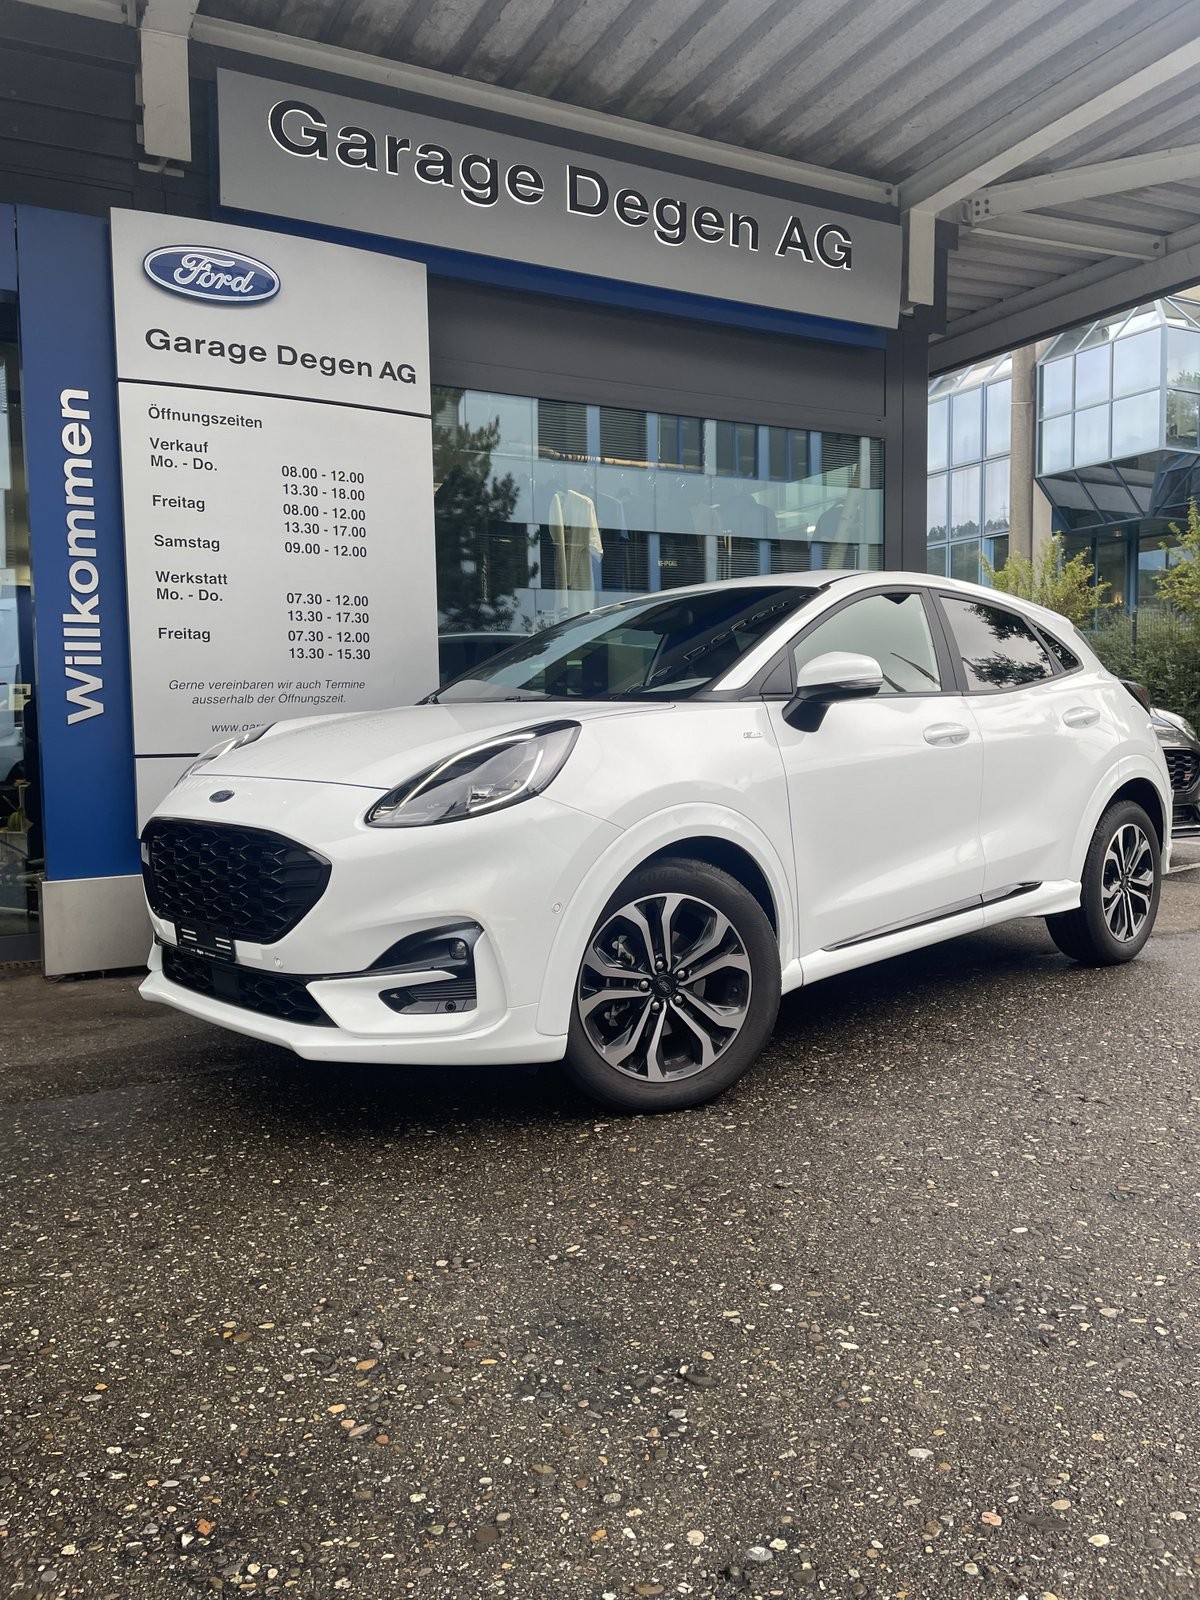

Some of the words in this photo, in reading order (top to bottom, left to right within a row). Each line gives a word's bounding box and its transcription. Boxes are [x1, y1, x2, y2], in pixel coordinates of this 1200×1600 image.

[268, 100, 544, 207] Garage
[566, 164, 758, 251] Degen
[775, 215, 852, 270] AG
[173, 253, 255, 293] Ford
[145, 328, 267, 364] Garage
[277, 345, 373, 376] Degen
[378, 360, 417, 385] AG
[148, 403, 263, 429] Öffnungszeiten
[149, 436, 209, 454] Verkauf
[150, 454, 178, 469] Mo.
[192, 457, 218, 472] Do.
[281, 465, 318, 480] 08.00
[330, 469, 365, 484] 12.00
[282, 483, 319, 498] 13.30
[331, 487, 365, 502] 18.00
[152, 494, 205, 513] Freitag
[282, 503, 319, 518] 08.00
[332, 507, 366, 521] 12.00
[284, 521, 320, 535] 13.30
[332, 524, 367, 538] 17.00
[153, 534, 220, 553] Samstag
[284, 541, 321, 555] 09.00
[333, 544, 368, 558] 12.00
[60, 388, 104, 725] Willkommen
[154, 570, 228, 585] Werkstatt
[156, 587, 184, 601] Mo.
[198, 588, 223, 602] Do.
[286, 592, 323, 605] 07.30
[335, 594, 369, 607] 12.00
[287, 609, 323, 623] 13.30
[335, 611, 370, 624] 17.30
[157, 627, 211, 643] Freitag
[287, 629, 324, 642] 07.30
[336, 631, 370, 644] 12.00
[288, 647, 325, 660] 13.30
[336, 648, 371, 660] 15.30
[168, 679, 205, 691] Gerne
[208, 679, 274, 690] vereinbaren
[277, 680, 294, 689] wir
[295, 679, 322, 690] auch
[324, 679, 366, 690] Termine
[191, 693, 255, 705] ausserhalb
[256, 693, 276, 704] der
[278, 691, 346, 706] Öffnungszeit.
